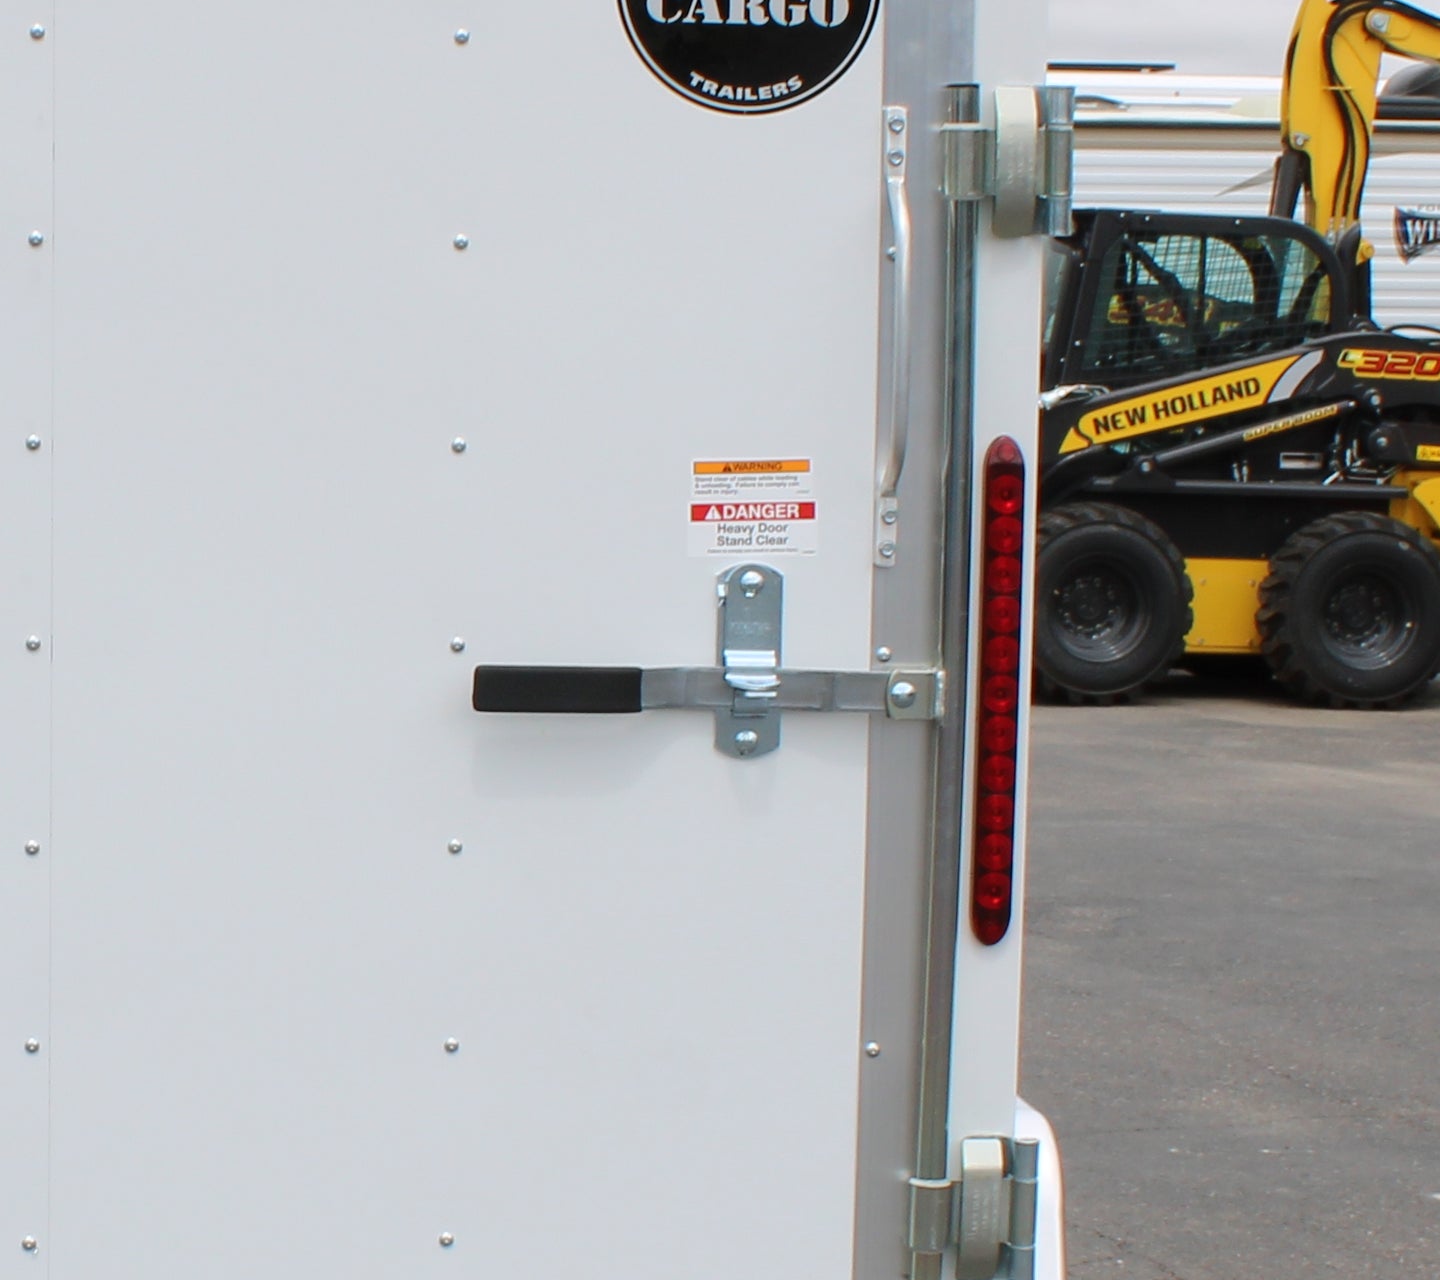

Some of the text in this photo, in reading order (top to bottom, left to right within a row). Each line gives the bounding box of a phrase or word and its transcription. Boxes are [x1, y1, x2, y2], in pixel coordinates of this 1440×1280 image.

[689, 71, 804, 102] TRAILERS
[1092, 377, 1261, 436] NEW HOLLAND
[733, 461, 783, 472] WARNING
[722, 504, 800, 520] DANGER
[717, 522, 789, 535] Heavy Door
[717, 535, 789, 547] Stand Clear
